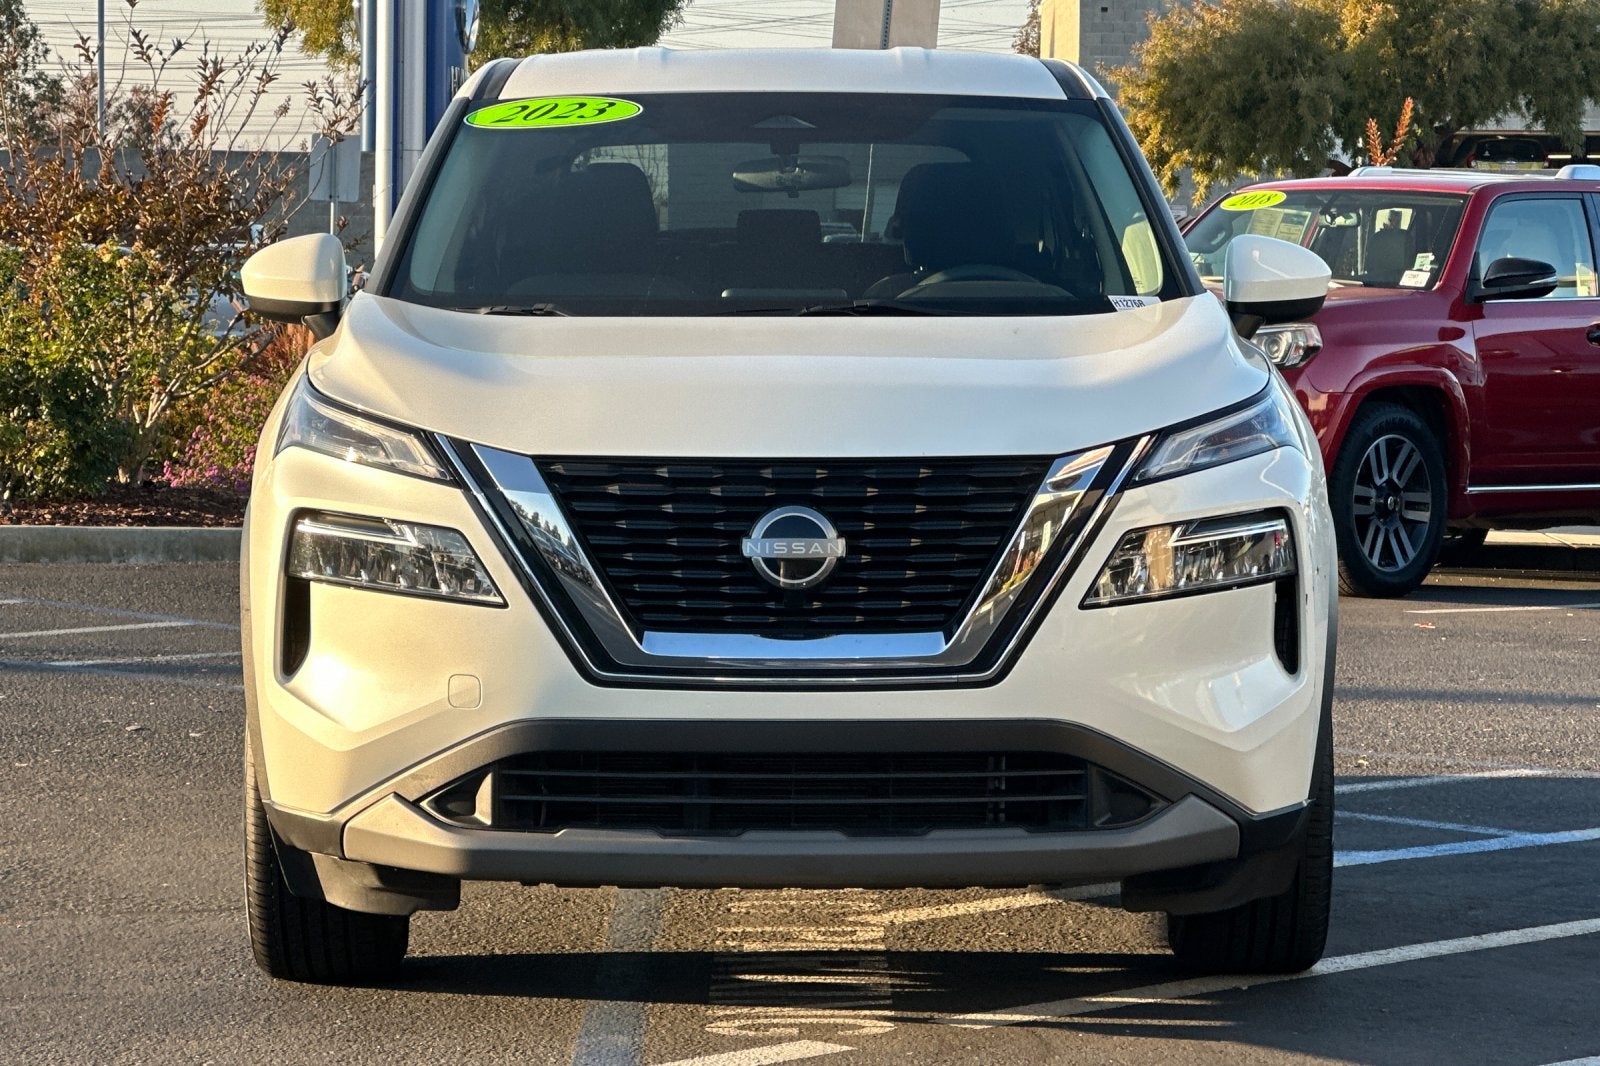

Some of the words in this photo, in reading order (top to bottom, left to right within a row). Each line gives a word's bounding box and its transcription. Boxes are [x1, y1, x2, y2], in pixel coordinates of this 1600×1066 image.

[491, 101, 617, 124] 2023
[1229, 193, 1278, 207] 2018
[746, 541, 843, 554] NISSAN
